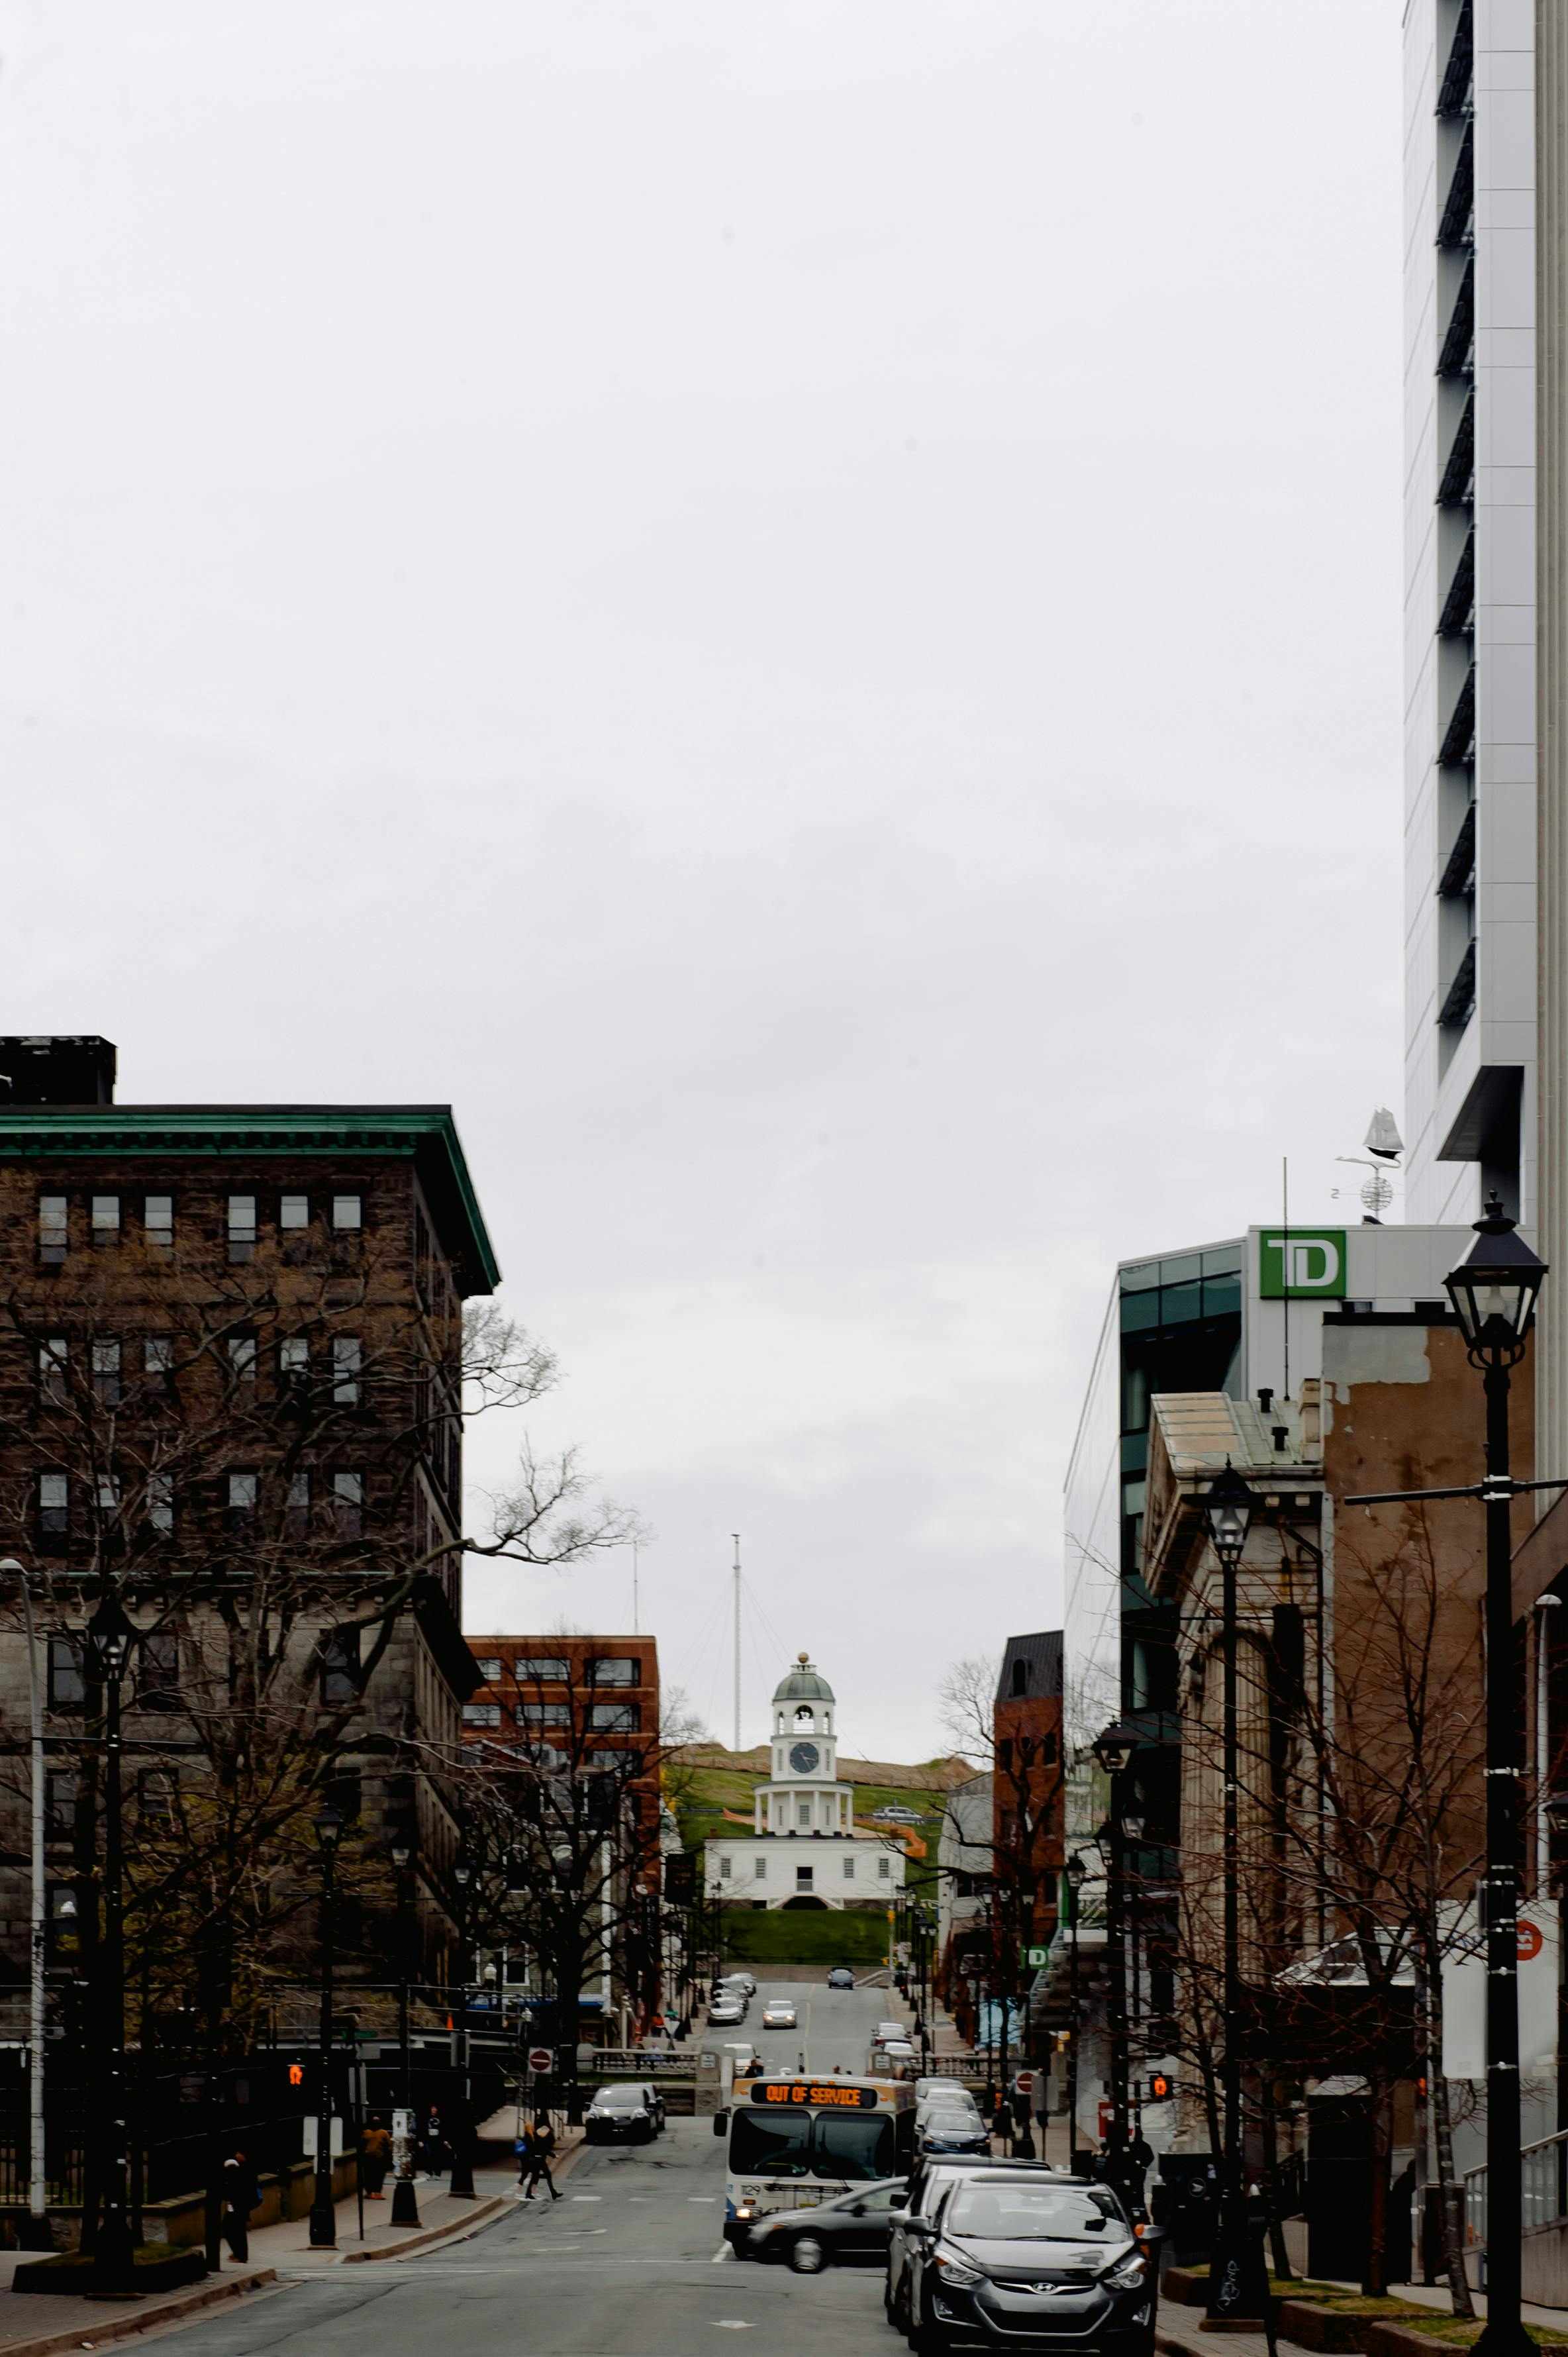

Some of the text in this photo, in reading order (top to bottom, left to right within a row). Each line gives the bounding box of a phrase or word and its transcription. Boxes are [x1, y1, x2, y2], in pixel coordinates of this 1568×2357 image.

[1267, 1239, 1339, 1287] TD
[1023, 1949, 1046, 1965] D
[766, 2085, 861, 2105] OUT OF SERVICE
